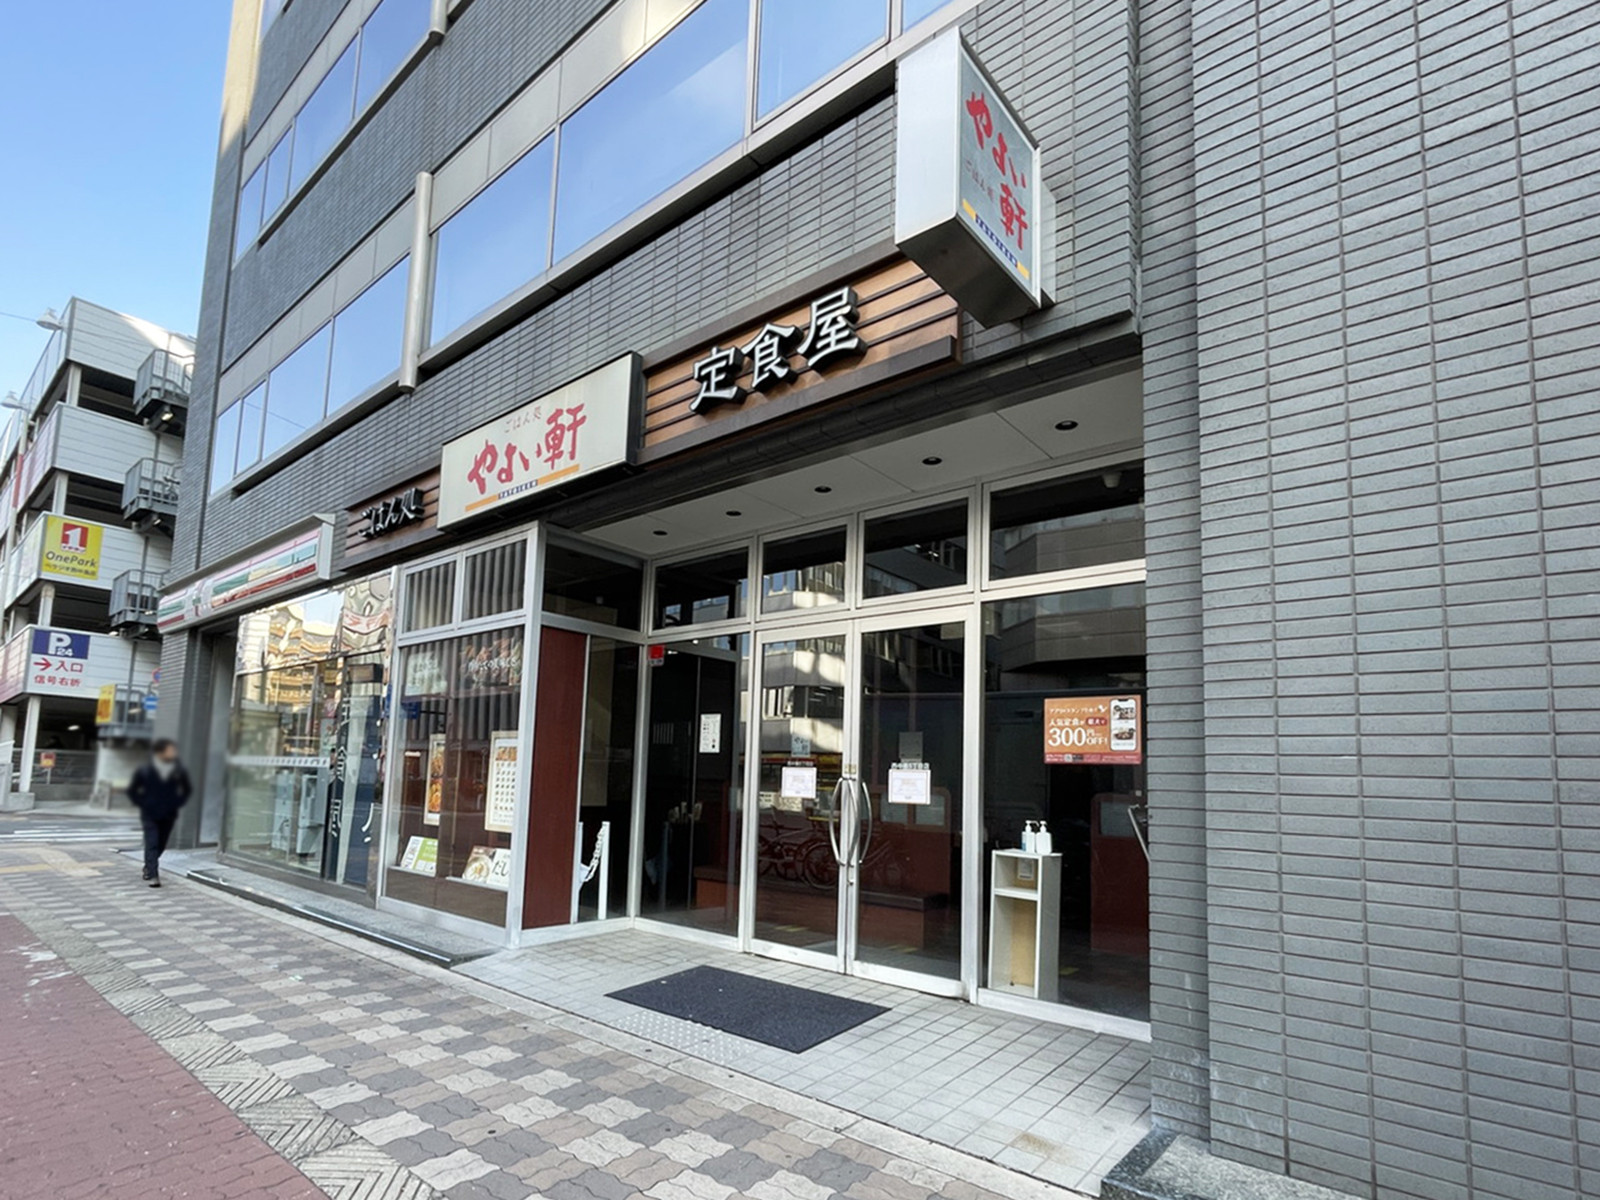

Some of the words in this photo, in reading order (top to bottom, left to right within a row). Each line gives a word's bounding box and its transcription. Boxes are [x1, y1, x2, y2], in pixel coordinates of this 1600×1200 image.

[966, 91, 1028, 251] やよい軒
[689, 286, 862, 412] 定食屋
[467, 403, 587, 495] やよい軒
[358, 487, 419, 535] ごはん処
[46, 551, 97, 567] OnePark
[48, 632, 72, 655] P
[57, 647, 73, 657] 24
[55, 660, 83, 673] 入口
[34, 675, 81, 687] 信号右折
